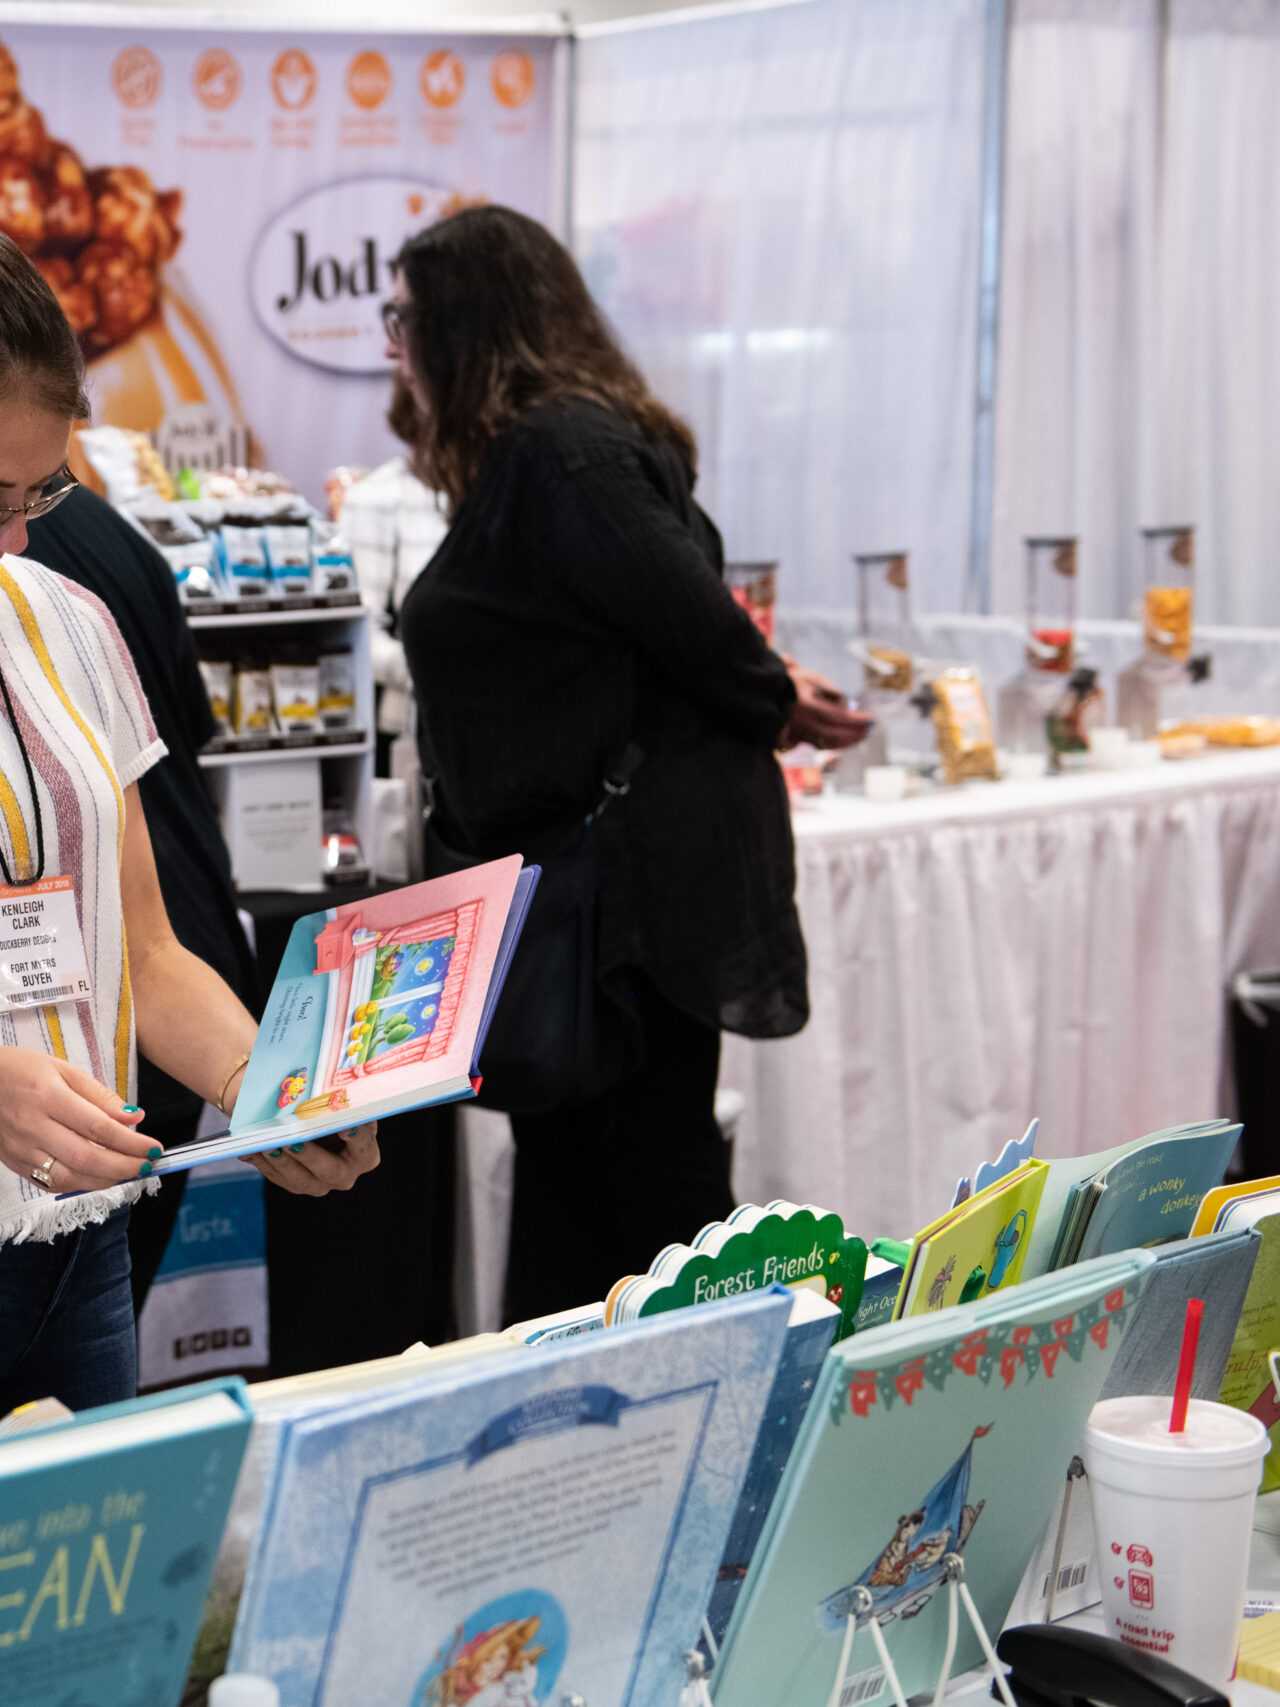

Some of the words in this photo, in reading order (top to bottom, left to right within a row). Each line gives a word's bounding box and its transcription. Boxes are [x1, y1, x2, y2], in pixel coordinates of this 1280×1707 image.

[277, 228, 398, 312] Jod
[36, 881, 55, 891] JULY
[1, 900, 44, 917] KENLEIGH
[12, 916, 40, 930] CLARK
[0, 937, 31, 951] DUCKBERRY
[10, 961, 29, 974] FORT
[21, 972, 53, 987] BUYER
[78, 980, 90, 991] FL
[1149, 1176, 1186, 1195] wonky
[694, 1268, 755, 1304] Forest
[762, 1241, 824, 1287] Friends
[1123, 1621, 1149, 1637] road
[1151, 1628, 1175, 1642] trip
